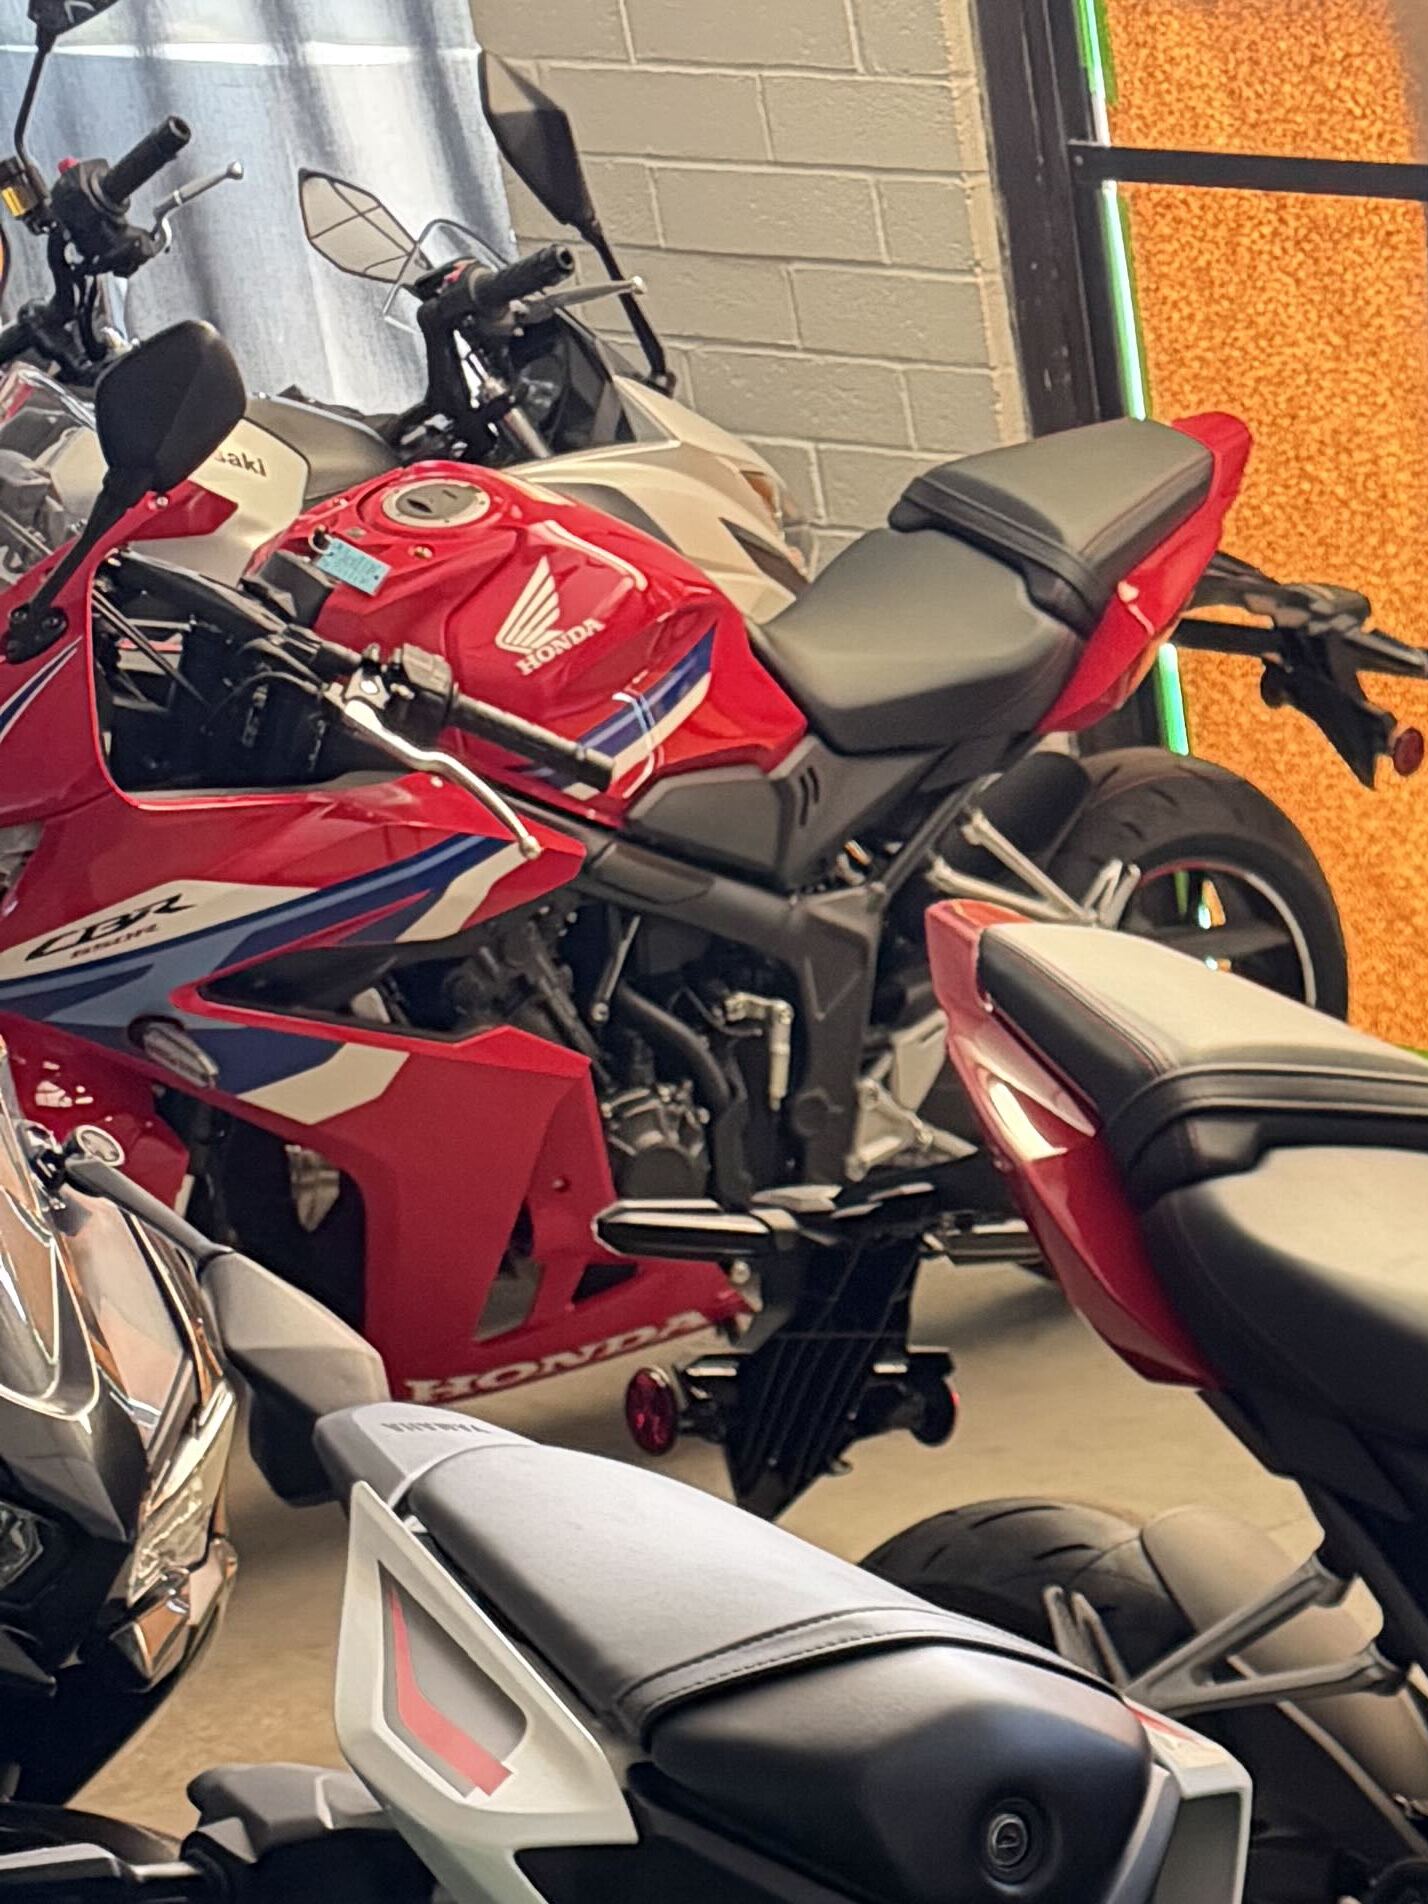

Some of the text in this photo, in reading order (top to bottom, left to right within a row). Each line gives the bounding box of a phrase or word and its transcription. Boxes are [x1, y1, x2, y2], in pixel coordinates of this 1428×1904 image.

[515, 618, 606, 676] HONDA
[25, 893, 196, 961] CBR
[404, 1311, 710, 1403] HONDA
